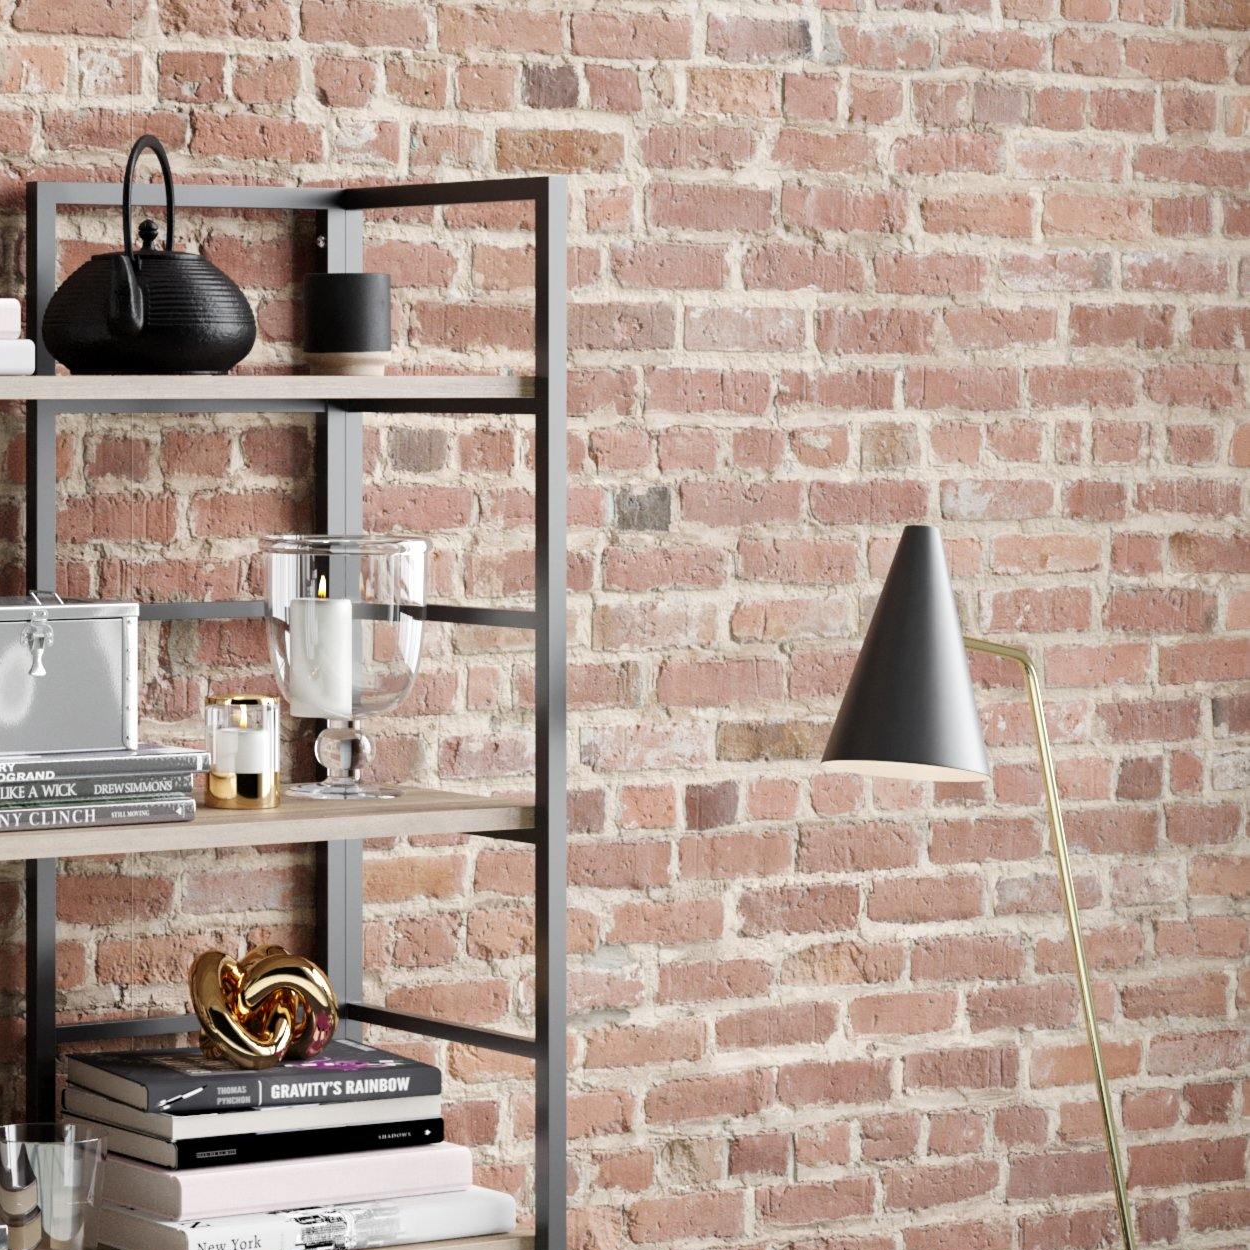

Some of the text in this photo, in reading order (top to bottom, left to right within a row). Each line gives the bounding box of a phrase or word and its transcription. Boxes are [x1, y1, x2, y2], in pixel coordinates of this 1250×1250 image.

[0, 786, 25, 800] LIKE
[28, 785, 38, 799] A
[41, 783, 77, 797] WICK
[93, 783, 125, 795] DREW
[125, 780, 173, 793] SIMMONS
[28, 808, 96, 826] CLINCH
[217, 1085, 247, 1095] THOMAS
[270, 1076, 410, 1100] GRAVITY'S RAINBOW
[216, 1095, 251, 1106] PYNCHON
[231, 1235, 262, 1250] York
